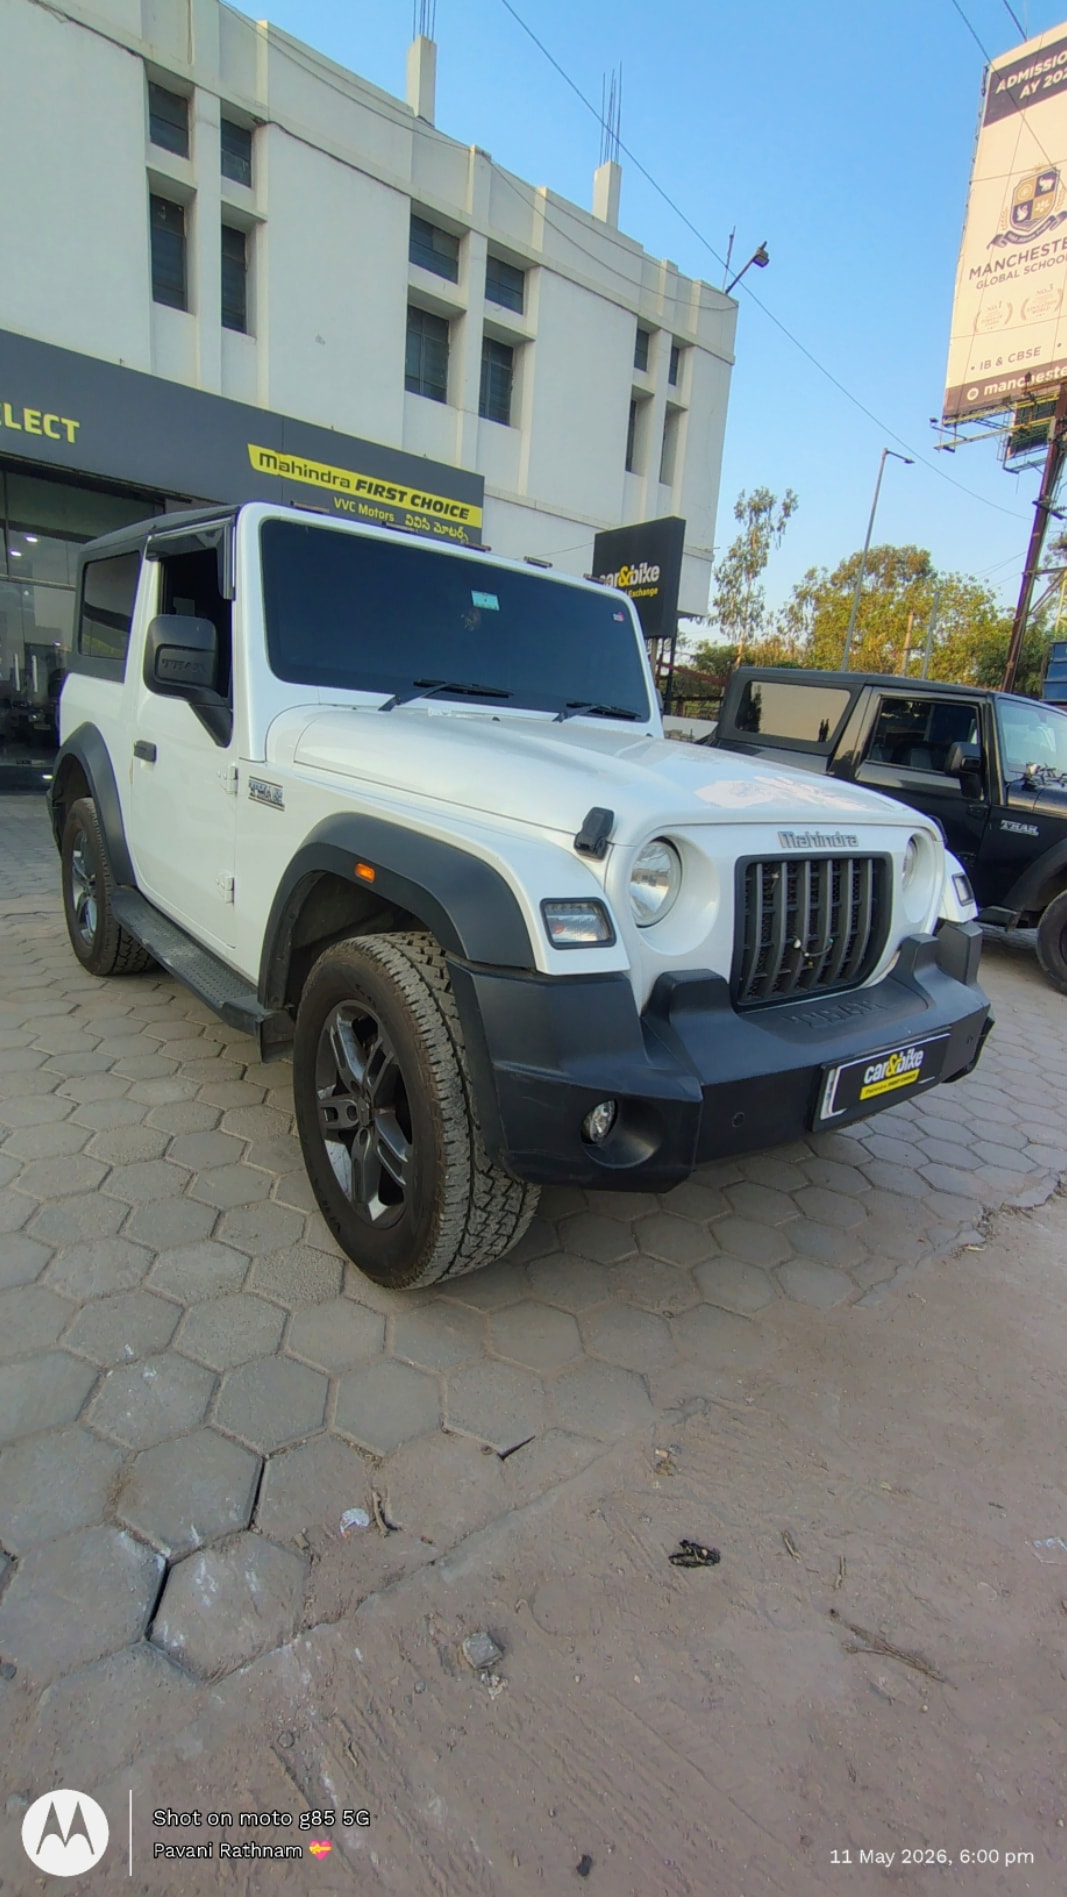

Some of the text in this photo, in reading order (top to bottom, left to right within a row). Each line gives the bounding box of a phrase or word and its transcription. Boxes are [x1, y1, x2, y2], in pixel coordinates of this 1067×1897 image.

[1019, 79, 1040, 99] AY
[976, 270, 1020, 290] GLOBAL
[980, 346, 1041, 371] IB & CBSE
[0, 402, 80, 443] LECT
[334, 496, 395, 522] VVC Motors
[355, 479, 407, 503] FIRST
[411, 494, 470, 520] CHOICE
[863, 1047, 925, 1085] car&bike
